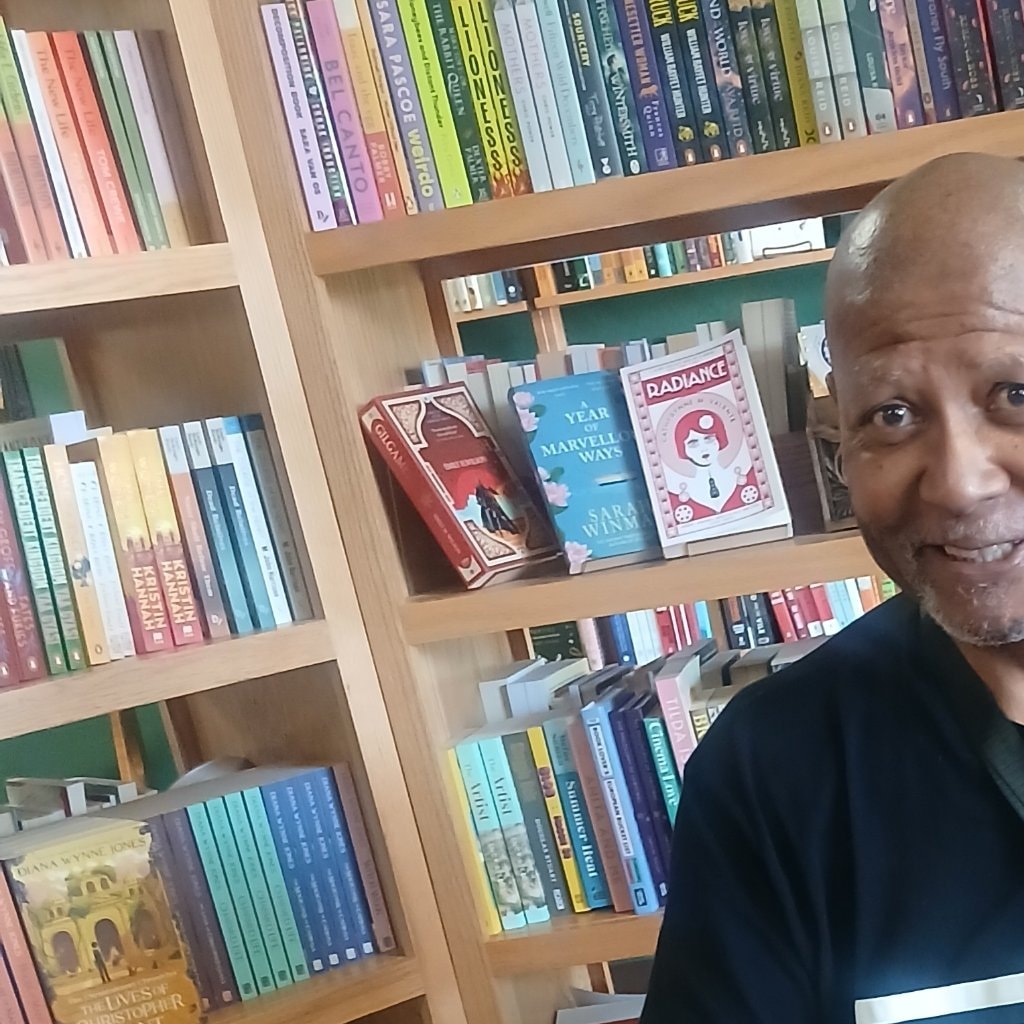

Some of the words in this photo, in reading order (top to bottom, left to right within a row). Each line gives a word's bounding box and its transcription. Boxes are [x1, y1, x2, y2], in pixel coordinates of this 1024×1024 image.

[406, 0, 425, 44] oneybees
[432, 3, 443, 24] THE
[927, 0, 940, 32] ranes
[270, 7, 295, 88] DECOMPOSITION
[290, 90, 303, 118] BOOK
[375, 0, 398, 48] SARA
[388, 53, 416, 123] PASCOE
[419, 44, 428, 60] and
[437, 26, 454, 69] RABBIT
[571, 12, 590, 68] SOURCERY
[713, 27, 732, 76] WORLD
[931, 35, 945, 52] Fly
[423, 62, 436, 92] Distant
[455, 5, 503, 172] LIONESS
[474, 0, 522, 168] LIONESS
[806, 29, 820, 75] LOUISA
[815, 81, 826, 111] REID
[829, 25, 844, 72] LOUISA
[838, 76, 850, 106] REID
[937, 56, 951, 89] South
[35, 48, 52, 74] The
[44, 77, 62, 108] New
[54, 111, 73, 140] Life
[63, 47, 79, 73] The
[72, 76, 90, 107] New
[82, 109, 100, 136] Life
[430, 94, 445, 128] Thunder
[445, 72, 466, 116] QUEEN
[609, 73, 637, 157] WINTERSMITH
[323, 58, 346, 100] BEL
[336, 108, 368, 194] CANTO
[95, 148, 112, 178] TOM
[406, 127, 437, 198] weirdo
[463, 146, 479, 184] PALMER
[646, 360, 729, 400] RADIANCE
[565, 408, 610, 425] YEAR
[584, 423, 599, 433] OF
[578, 448, 624, 465] WAYS
[26, 540, 49, 590] KINGDOM
[130, 566, 155, 630] HANNAH
[141, 564, 167, 629] KRISTIN
[159, 559, 185, 624] HANNAH
[171, 558, 196, 622] KRISTIN
[665, 697, 687, 740] TILDA
[647, 720, 673, 773] Cinema
[662, 773, 681, 806] Love
[592, 726, 602, 746] BOOK
[605, 779, 620, 816] EUROPEAN
[616, 816, 627, 841] BUCKET
[622, 841, 631, 855] LIST
[564, 779, 592, 842] Summer
[581, 843, 601, 877] Heat
[17, 860, 57, 877] DIANA
[62, 849, 105, 870] WYNNE
[109, 838, 146, 855] JONES
[81, 1001, 106, 1016] THE
[105, 986, 153, 1011] LIVES
[152, 983, 169, 996] OF
